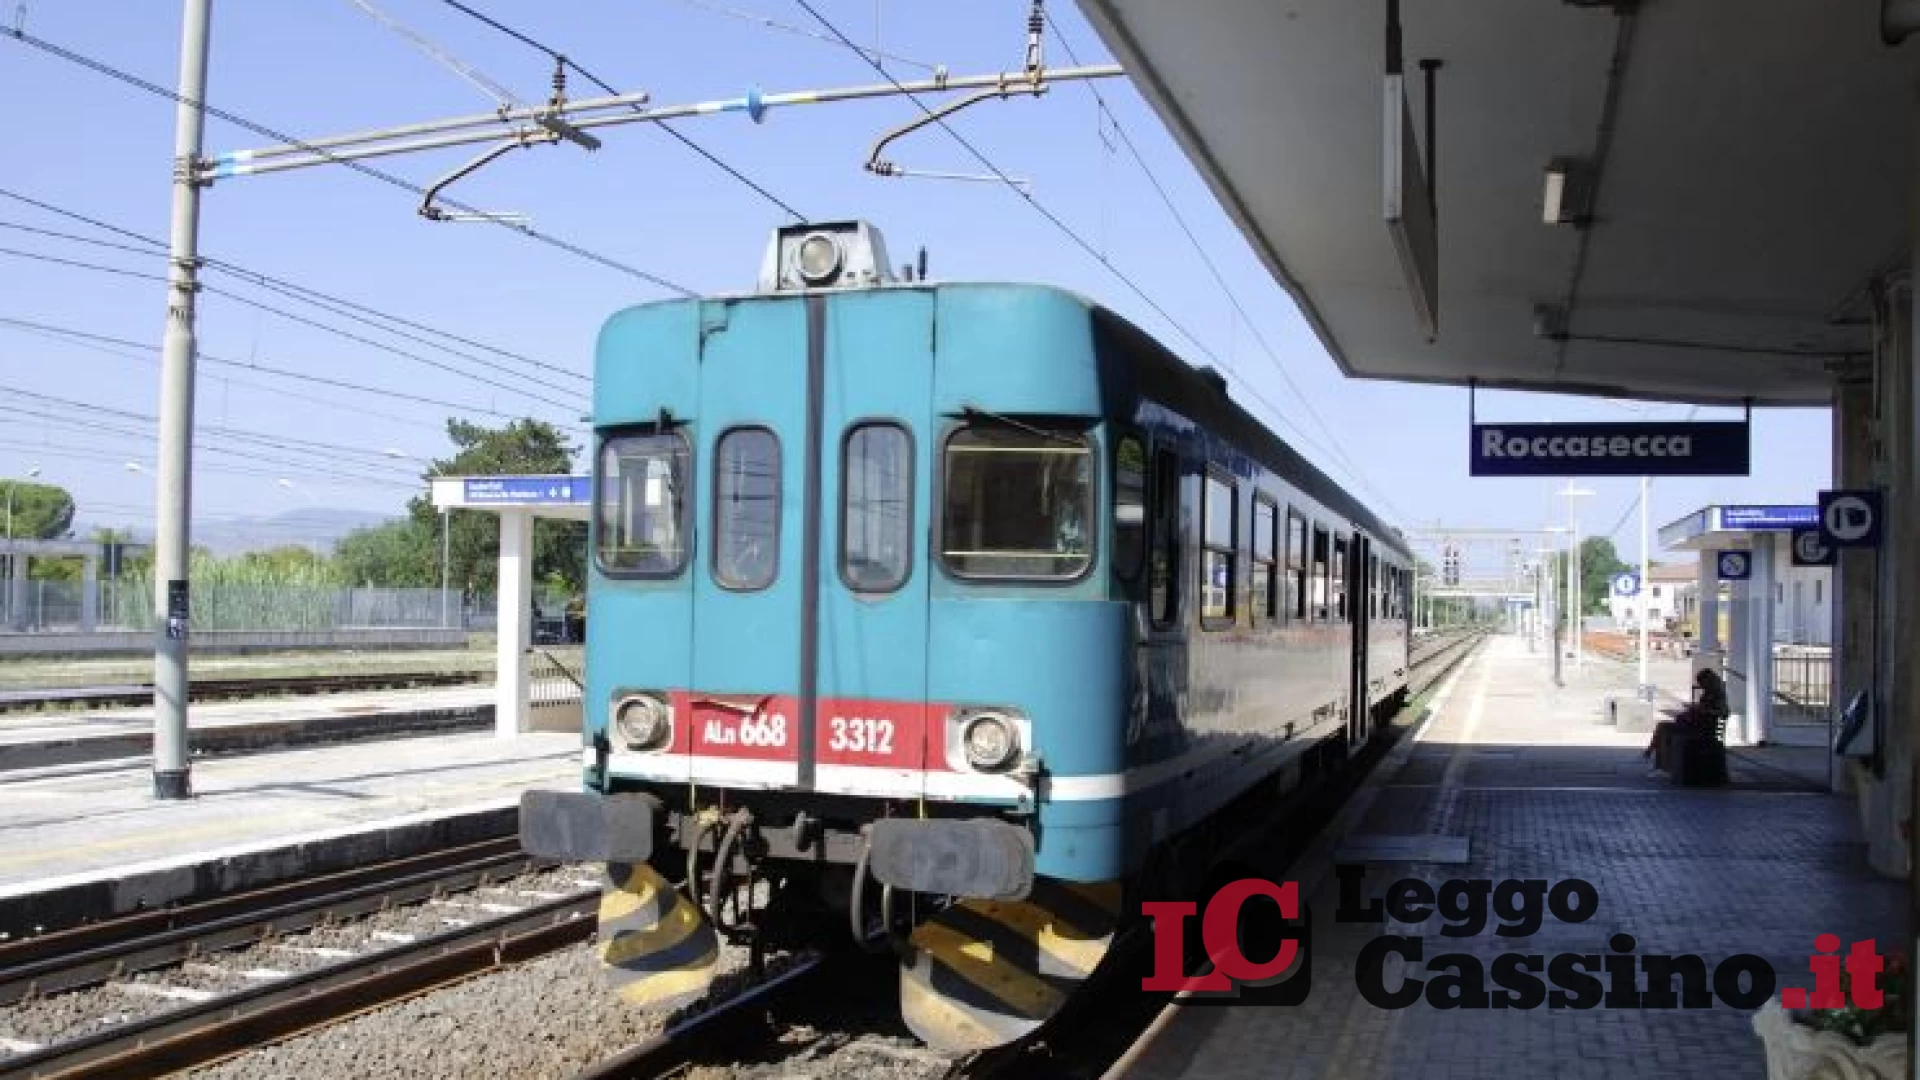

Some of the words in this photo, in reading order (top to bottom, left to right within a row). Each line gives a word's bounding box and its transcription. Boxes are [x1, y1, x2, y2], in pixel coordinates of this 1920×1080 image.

[1482, 429, 1693, 457] Roccasecca
[740, 713, 787, 747] 668
[829, 716, 895, 754] 3312
